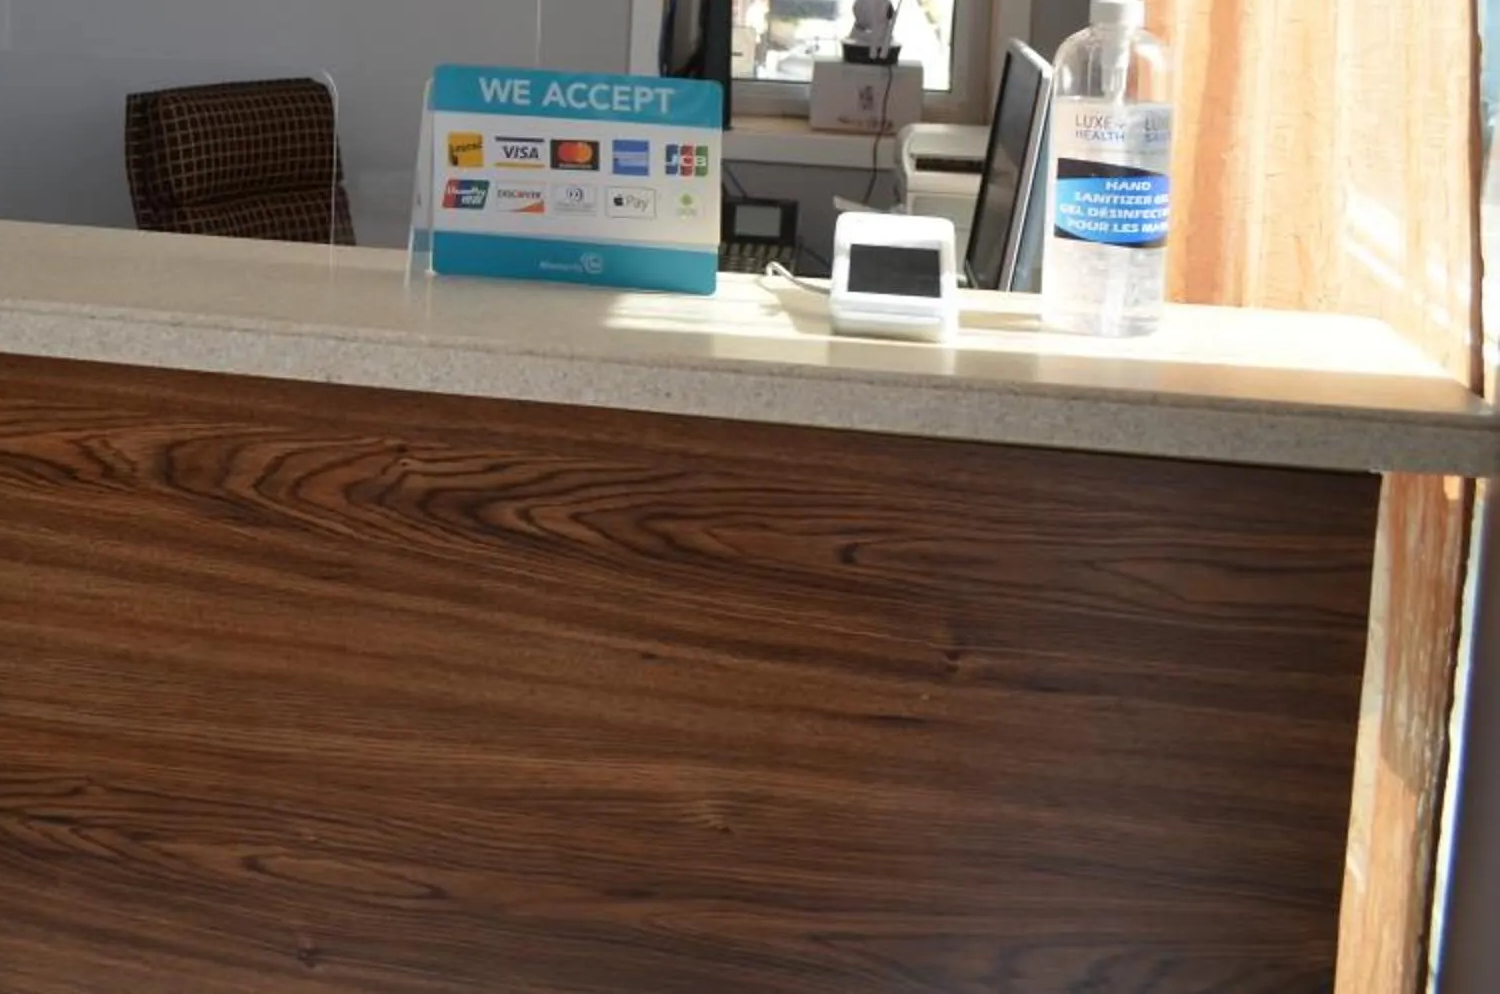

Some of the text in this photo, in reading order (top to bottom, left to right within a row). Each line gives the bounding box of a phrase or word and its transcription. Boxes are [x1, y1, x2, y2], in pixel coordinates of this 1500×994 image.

[478, 76, 676, 114] WE ACCEPT
[1074, 129, 1125, 142] HEALTH
[502, 145, 540, 159] VISA
[1105, 181, 1152, 191] HAND
[625, 194, 649, 213] Pay
[1113, 223, 1139, 233] LES
